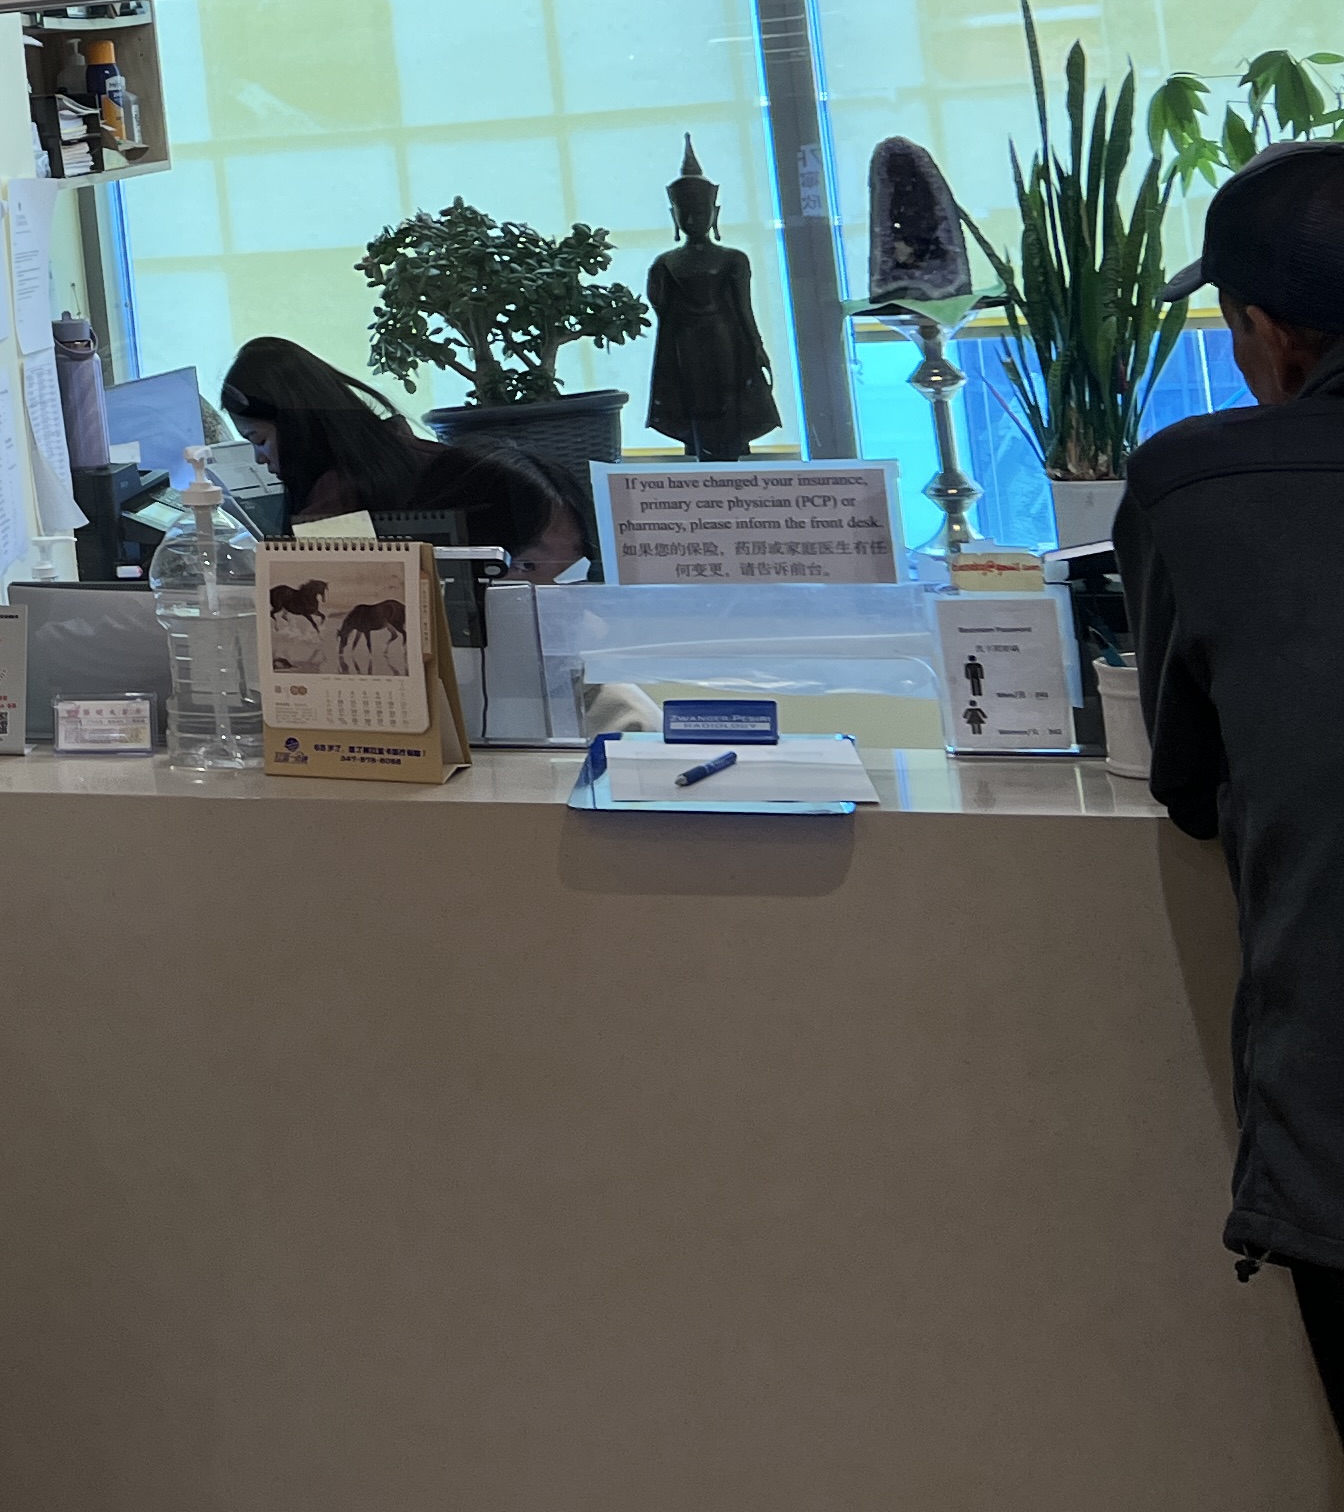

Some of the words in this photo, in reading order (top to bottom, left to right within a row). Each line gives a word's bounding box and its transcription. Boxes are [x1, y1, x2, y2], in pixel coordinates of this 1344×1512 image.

[625, 478, 637, 490] If
[639, 479, 664, 492] you
[667, 477, 700, 489] have
[702, 476, 759, 490] changed
[761, 477, 793, 491] your
[797, 474, 869, 487] insurance,
[640, 499, 692, 514] primary
[696, 498, 725, 509] care
[727, 495, 791, 512] physician
[794, 494, 838, 510] (PCP)
[841, 498, 856, 507] or
[618, 519, 687, 535] pharmacy,
[689, 518, 733, 533] please
[735, 516, 782, 530] inform
[784, 517, 807, 530] the
[809, 516, 844, 530] front
[846, 515, 885, 529] desk.
